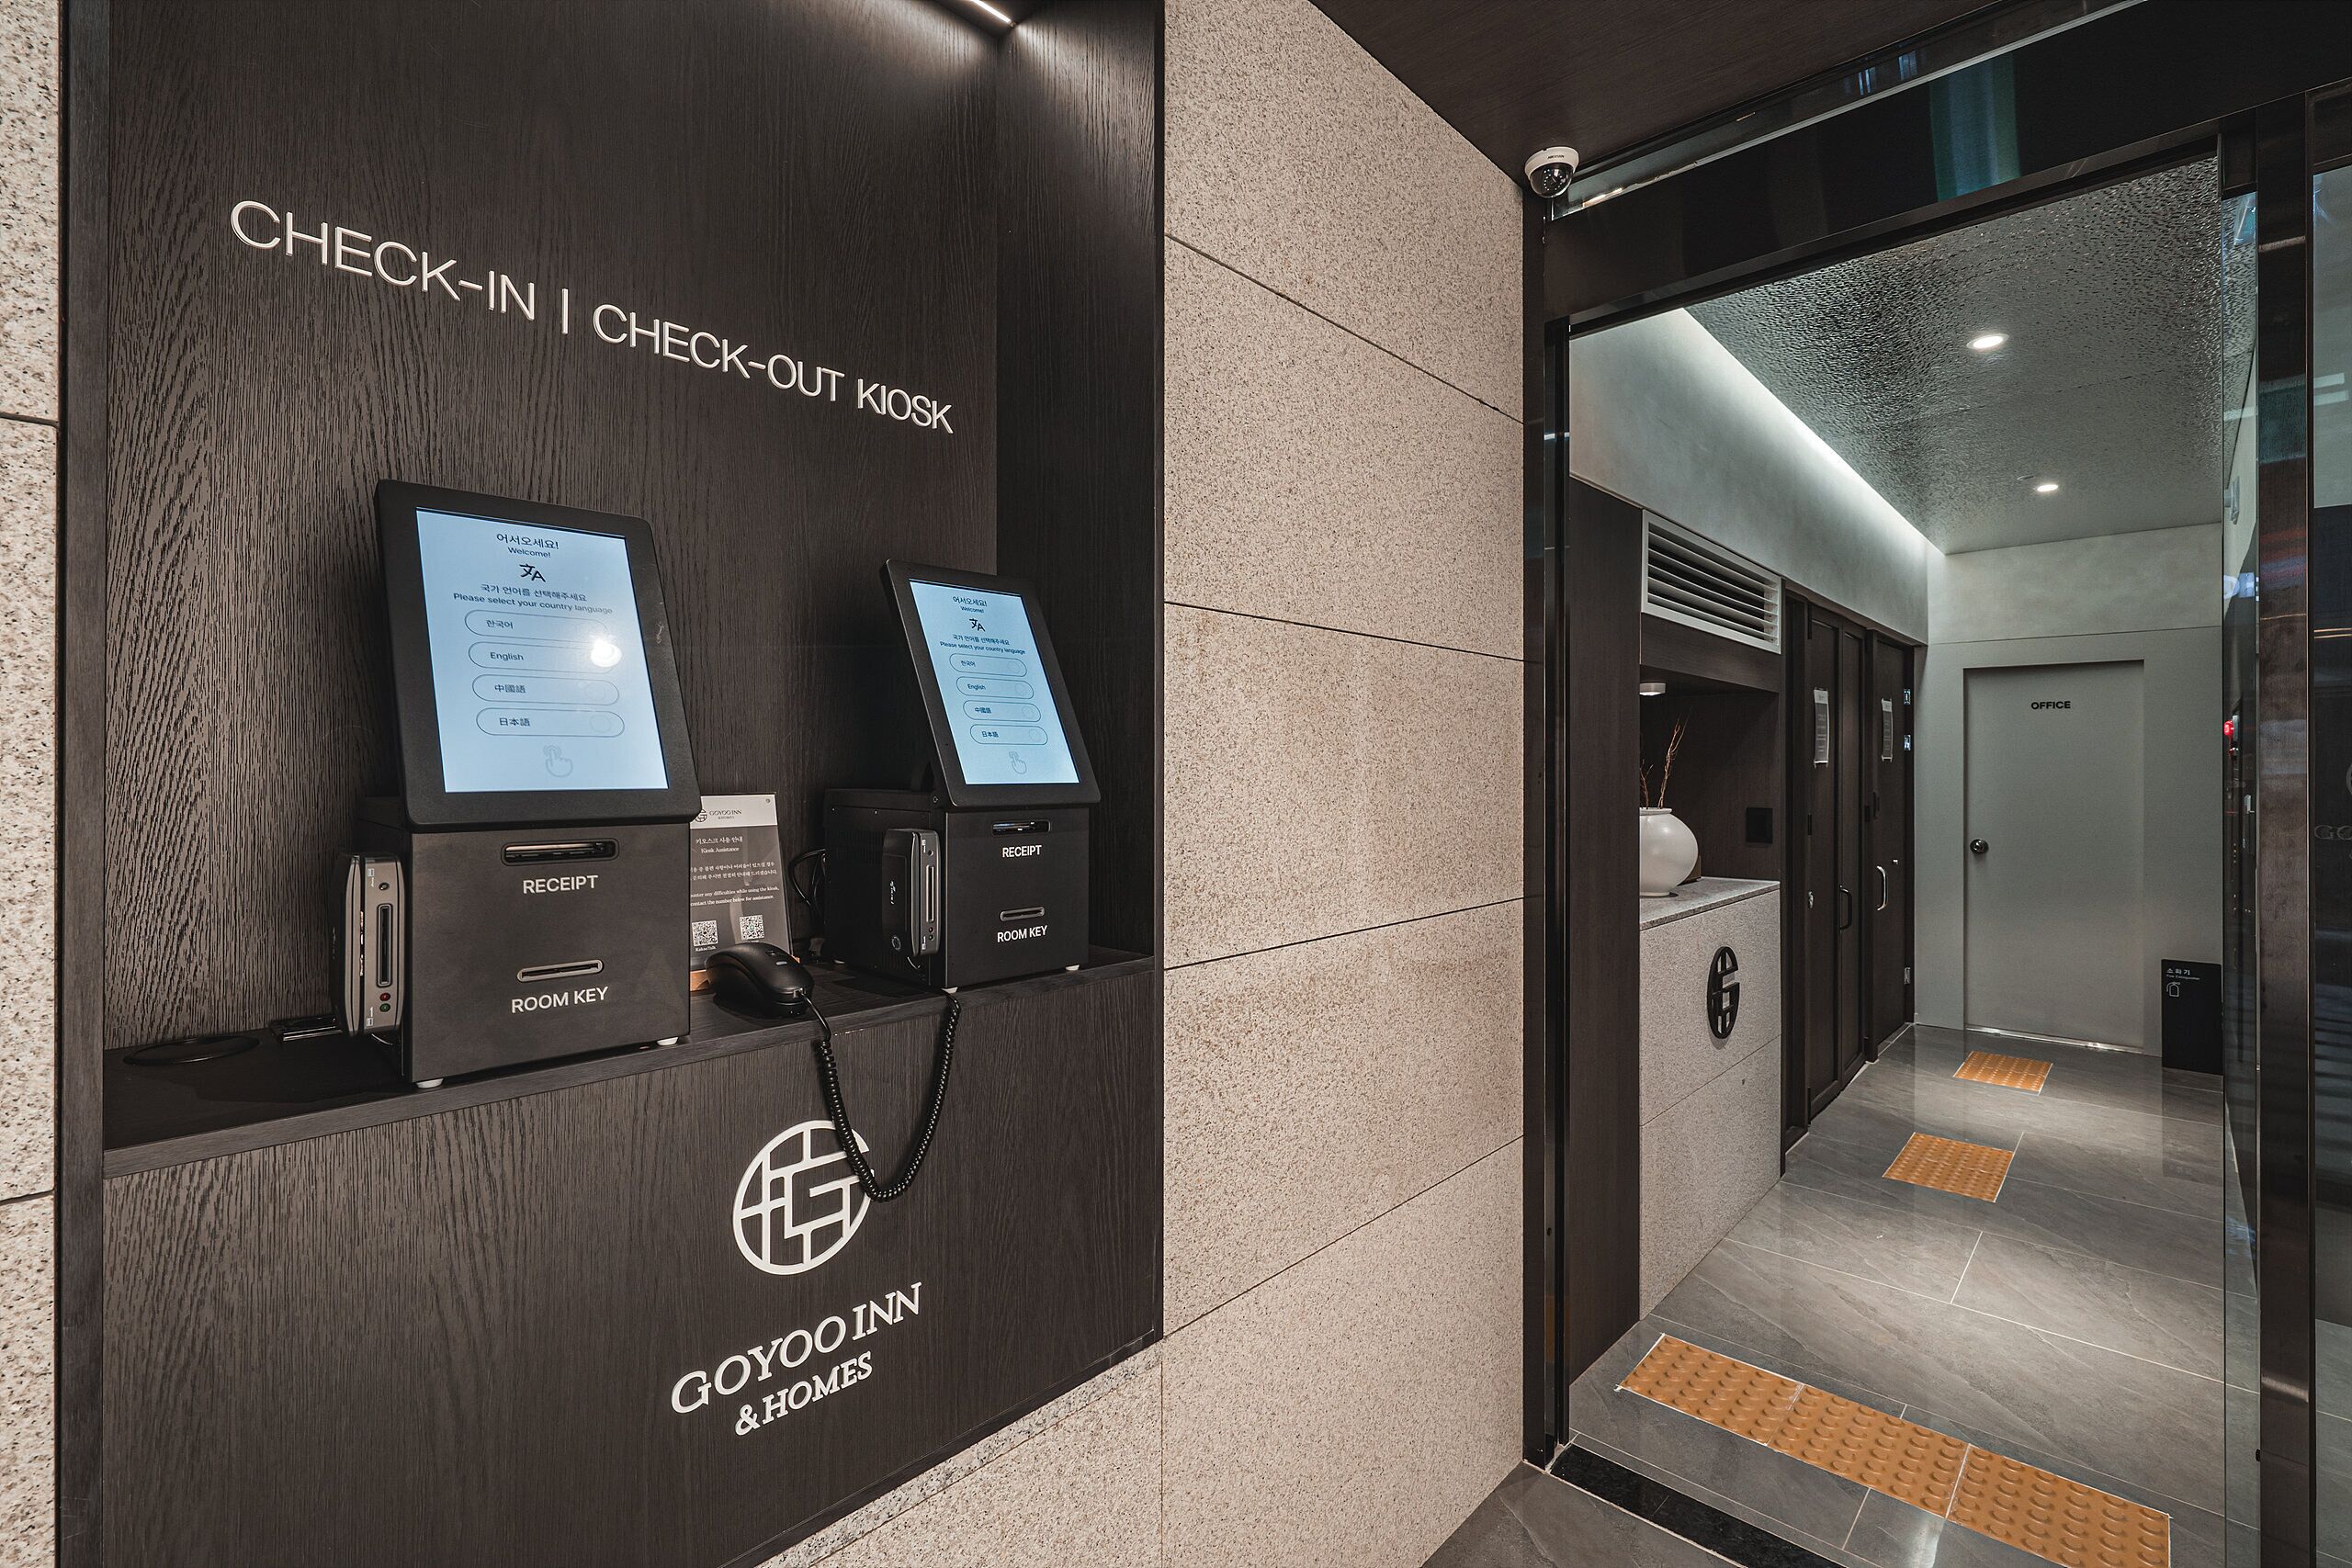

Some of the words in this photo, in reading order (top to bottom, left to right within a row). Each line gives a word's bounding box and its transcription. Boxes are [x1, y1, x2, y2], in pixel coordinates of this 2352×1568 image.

[230, 199, 536, 321] CHECK-IN
[593, 303, 845, 402] CHECK-OUT
[856, 378, 954, 434] KIOSK
[496, 533, 560, 550] 어서오세요!
[507, 547, 551, 558] Welcome!
[481, 583, 500, 594] 국가
[503, 585, 531, 597] 언어를
[534, 589, 588, 602] 선택해주세요
[453, 592, 486, 603] Please
[488, 597, 515, 606] select
[517, 600, 537, 608] your
[539, 603, 573, 612] country
[574, 604, 614, 615] language
[953, 596, 988, 607] 어서오세요!
[486, 619, 514, 629] 한국어
[490, 651, 525, 662] English
[2030, 701, 2072, 710] OFFICE
[499, 717, 530, 727] 日本語
[1001, 844, 1043, 859] RECEIPT
[522, 874, 598, 894] RECEIPT
[997, 928, 1028, 943] ROOM
[1029, 925, 1048, 938] KEY
[511, 991, 570, 1014] ROOM
[573, 986, 609, 1005] KEY
[671, 1315, 846, 1414] GOYOO
[852, 1281, 922, 1341] INN
